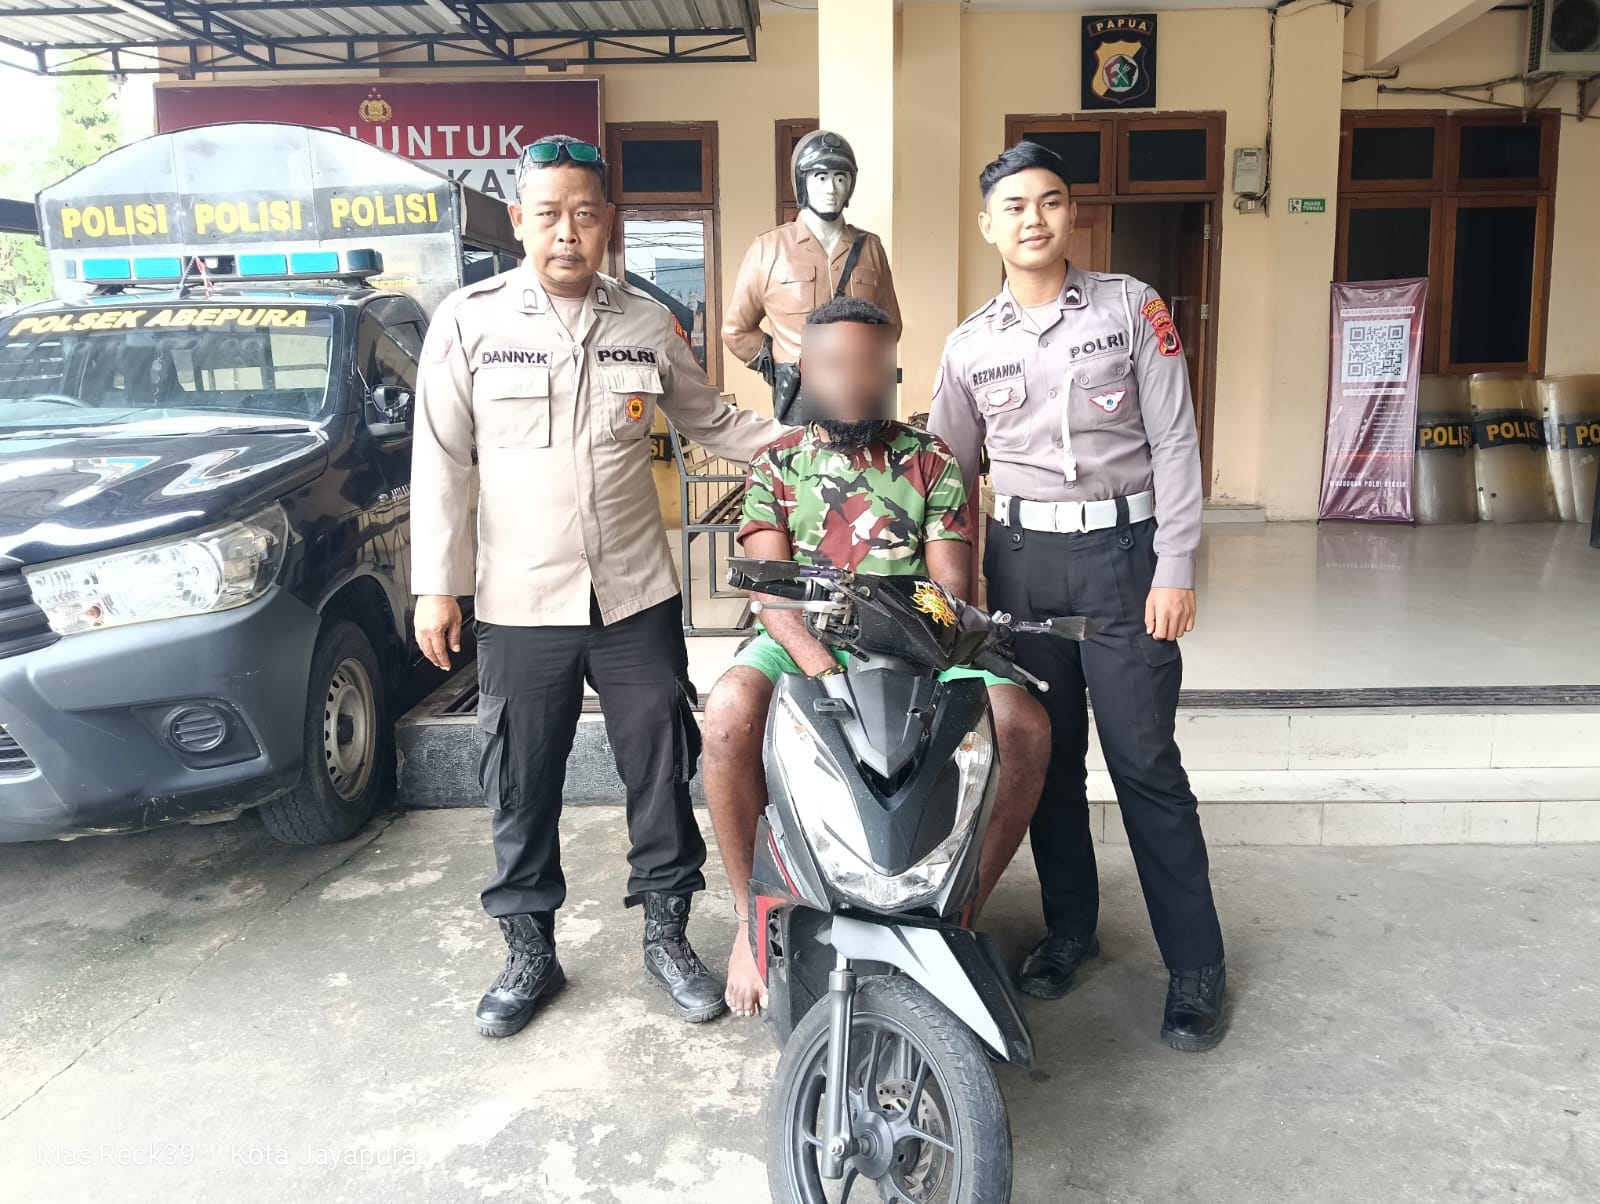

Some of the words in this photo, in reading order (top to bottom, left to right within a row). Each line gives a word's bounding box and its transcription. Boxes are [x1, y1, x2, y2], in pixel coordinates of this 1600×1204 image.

[1096, 18, 1147, 32] PAPUA
[374, 125, 525, 156] UNTUK
[60, 203, 168, 238] POLISI
[194, 200, 302, 234] POLISI
[330, 192, 438, 228] POLISI
[8, 309, 148, 337] POLSEK
[144, 308, 307, 328] ABEPURA
[597, 350, 656, 364] POLRI
[1069, 332, 1125, 359] POLRI
